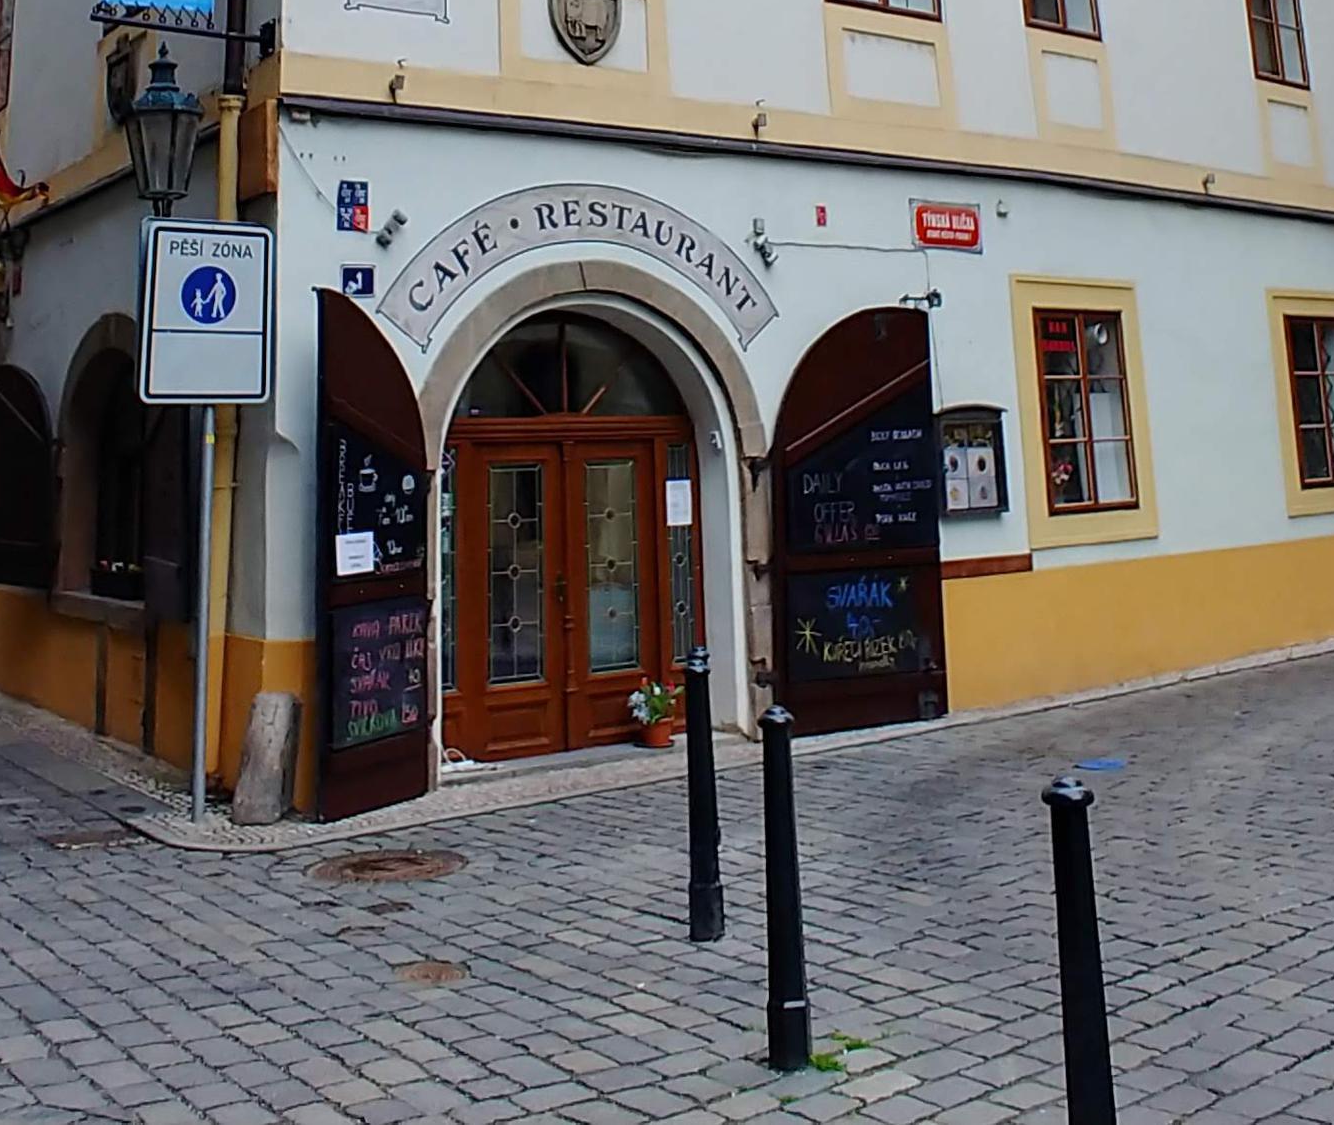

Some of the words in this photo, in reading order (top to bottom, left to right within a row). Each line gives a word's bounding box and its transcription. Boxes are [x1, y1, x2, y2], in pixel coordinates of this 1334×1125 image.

[169, 238, 204, 257] PĚŠÍ
[211, 241, 253, 259] ZÓNA
[408, 219, 499, 312] CAFÉ
[534, 200, 758, 314] RESTAURANT
[803, 473, 843, 494] DAILY
